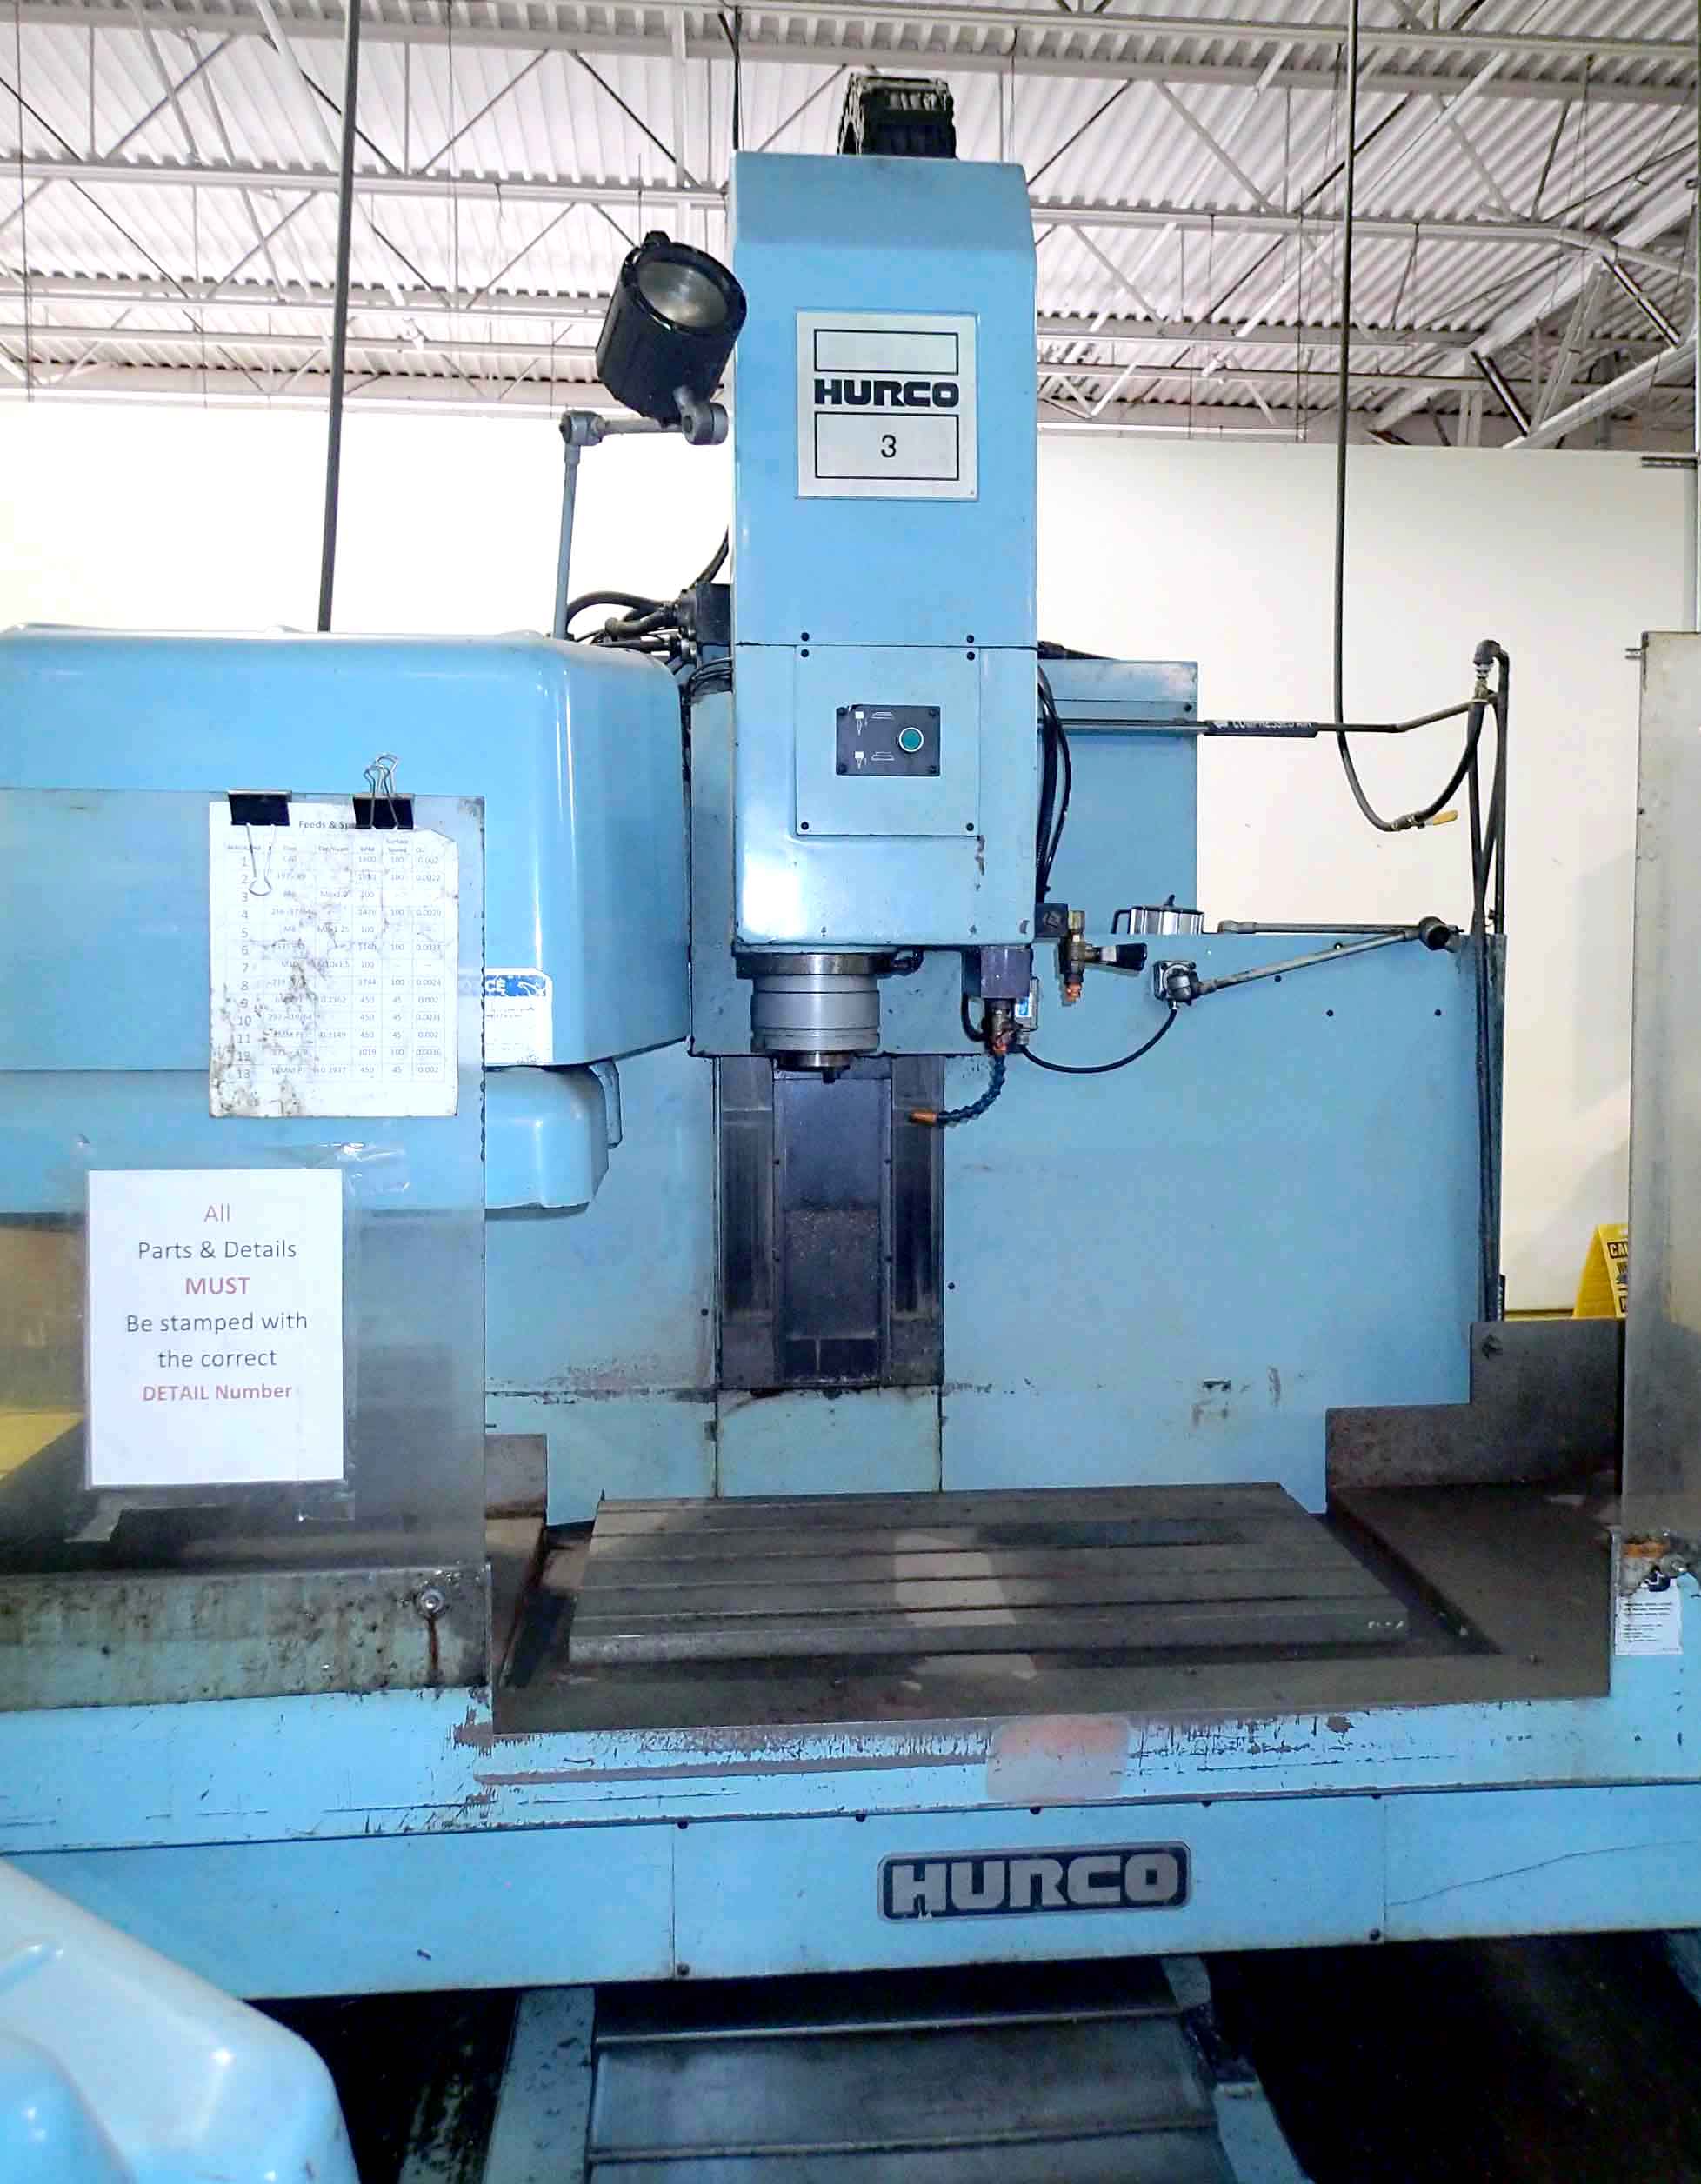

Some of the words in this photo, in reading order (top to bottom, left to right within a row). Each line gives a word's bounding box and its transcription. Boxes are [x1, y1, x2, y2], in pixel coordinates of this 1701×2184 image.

[814, 378, 960, 408] HURCO
[880, 434, 897, 458] 3
[299, 820, 326, 829] Feeds
[328, 820, 337, 829] &
[203, 1203, 231, 1223] All
[138, 1241, 193, 1260] Parts
[200, 1241, 217, 1259] &
[224, 1240, 297, 1259] Details
[185, 1276, 251, 1295] MUST
[126, 1315, 153, 1333] Be
[159, 1313, 254, 1335] stamped
[261, 1312, 308, 1330] with
[158, 1349, 193, 1368] the
[201, 1348, 277, 1368] correct
[143, 1385, 210, 1402] DETAIL
[215, 1383, 293, 1401] Number
[892, 1853, 1178, 1914] HURCO
